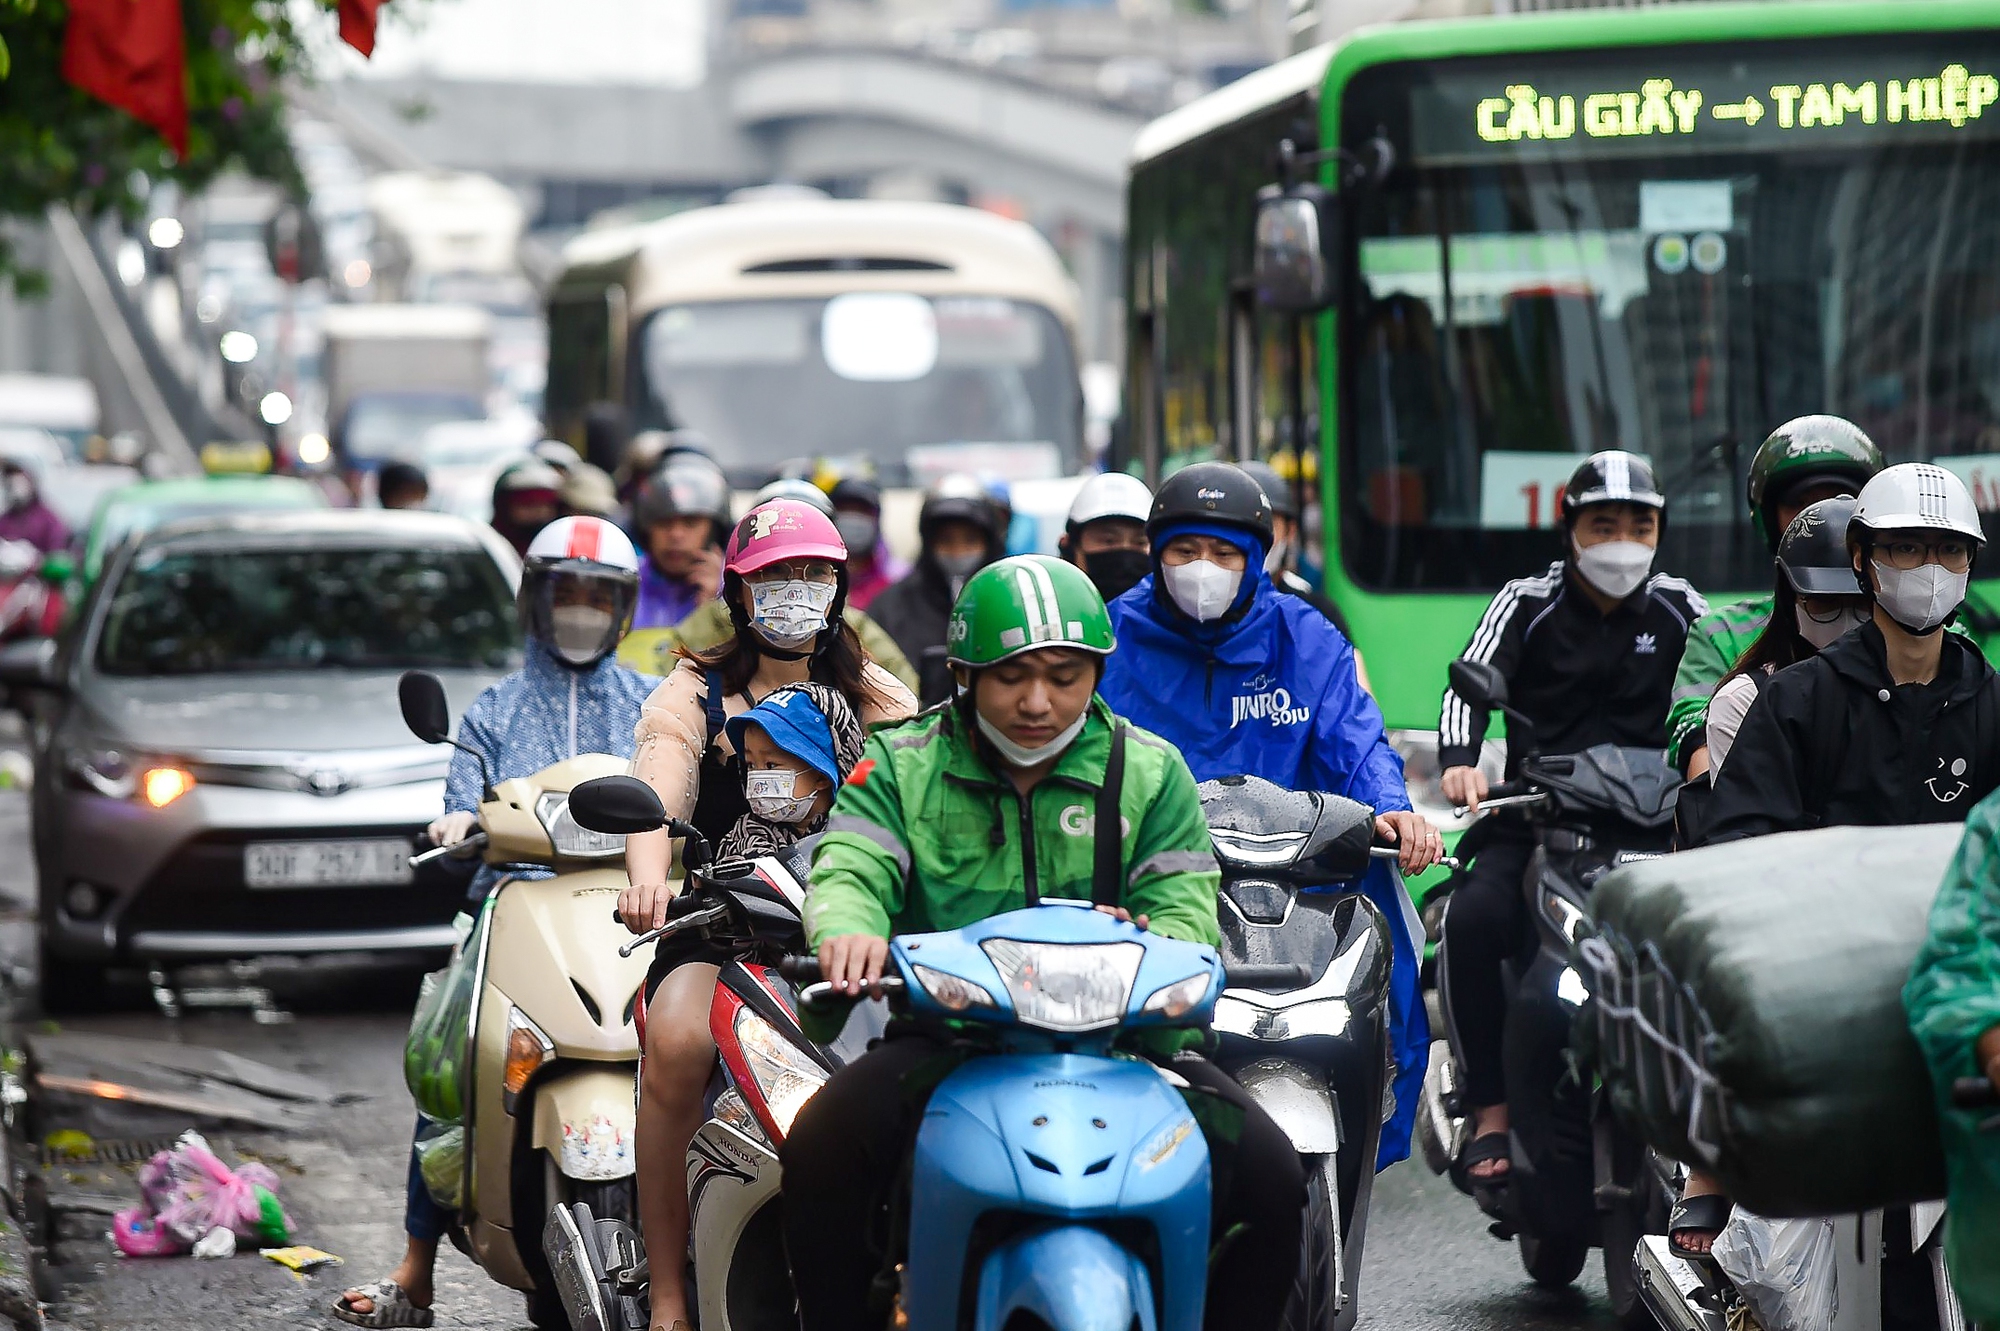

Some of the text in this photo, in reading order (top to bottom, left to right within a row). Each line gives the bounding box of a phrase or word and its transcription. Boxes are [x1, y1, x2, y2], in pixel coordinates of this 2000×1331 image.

[1770, 81, 1877, 128] TAM
[1519, 481, 1566, 529] 1
[1229, 687, 1291, 729] JINRO
[1270, 706, 1310, 727] SOJU
[719, 1137, 758, 1167] HONDA
